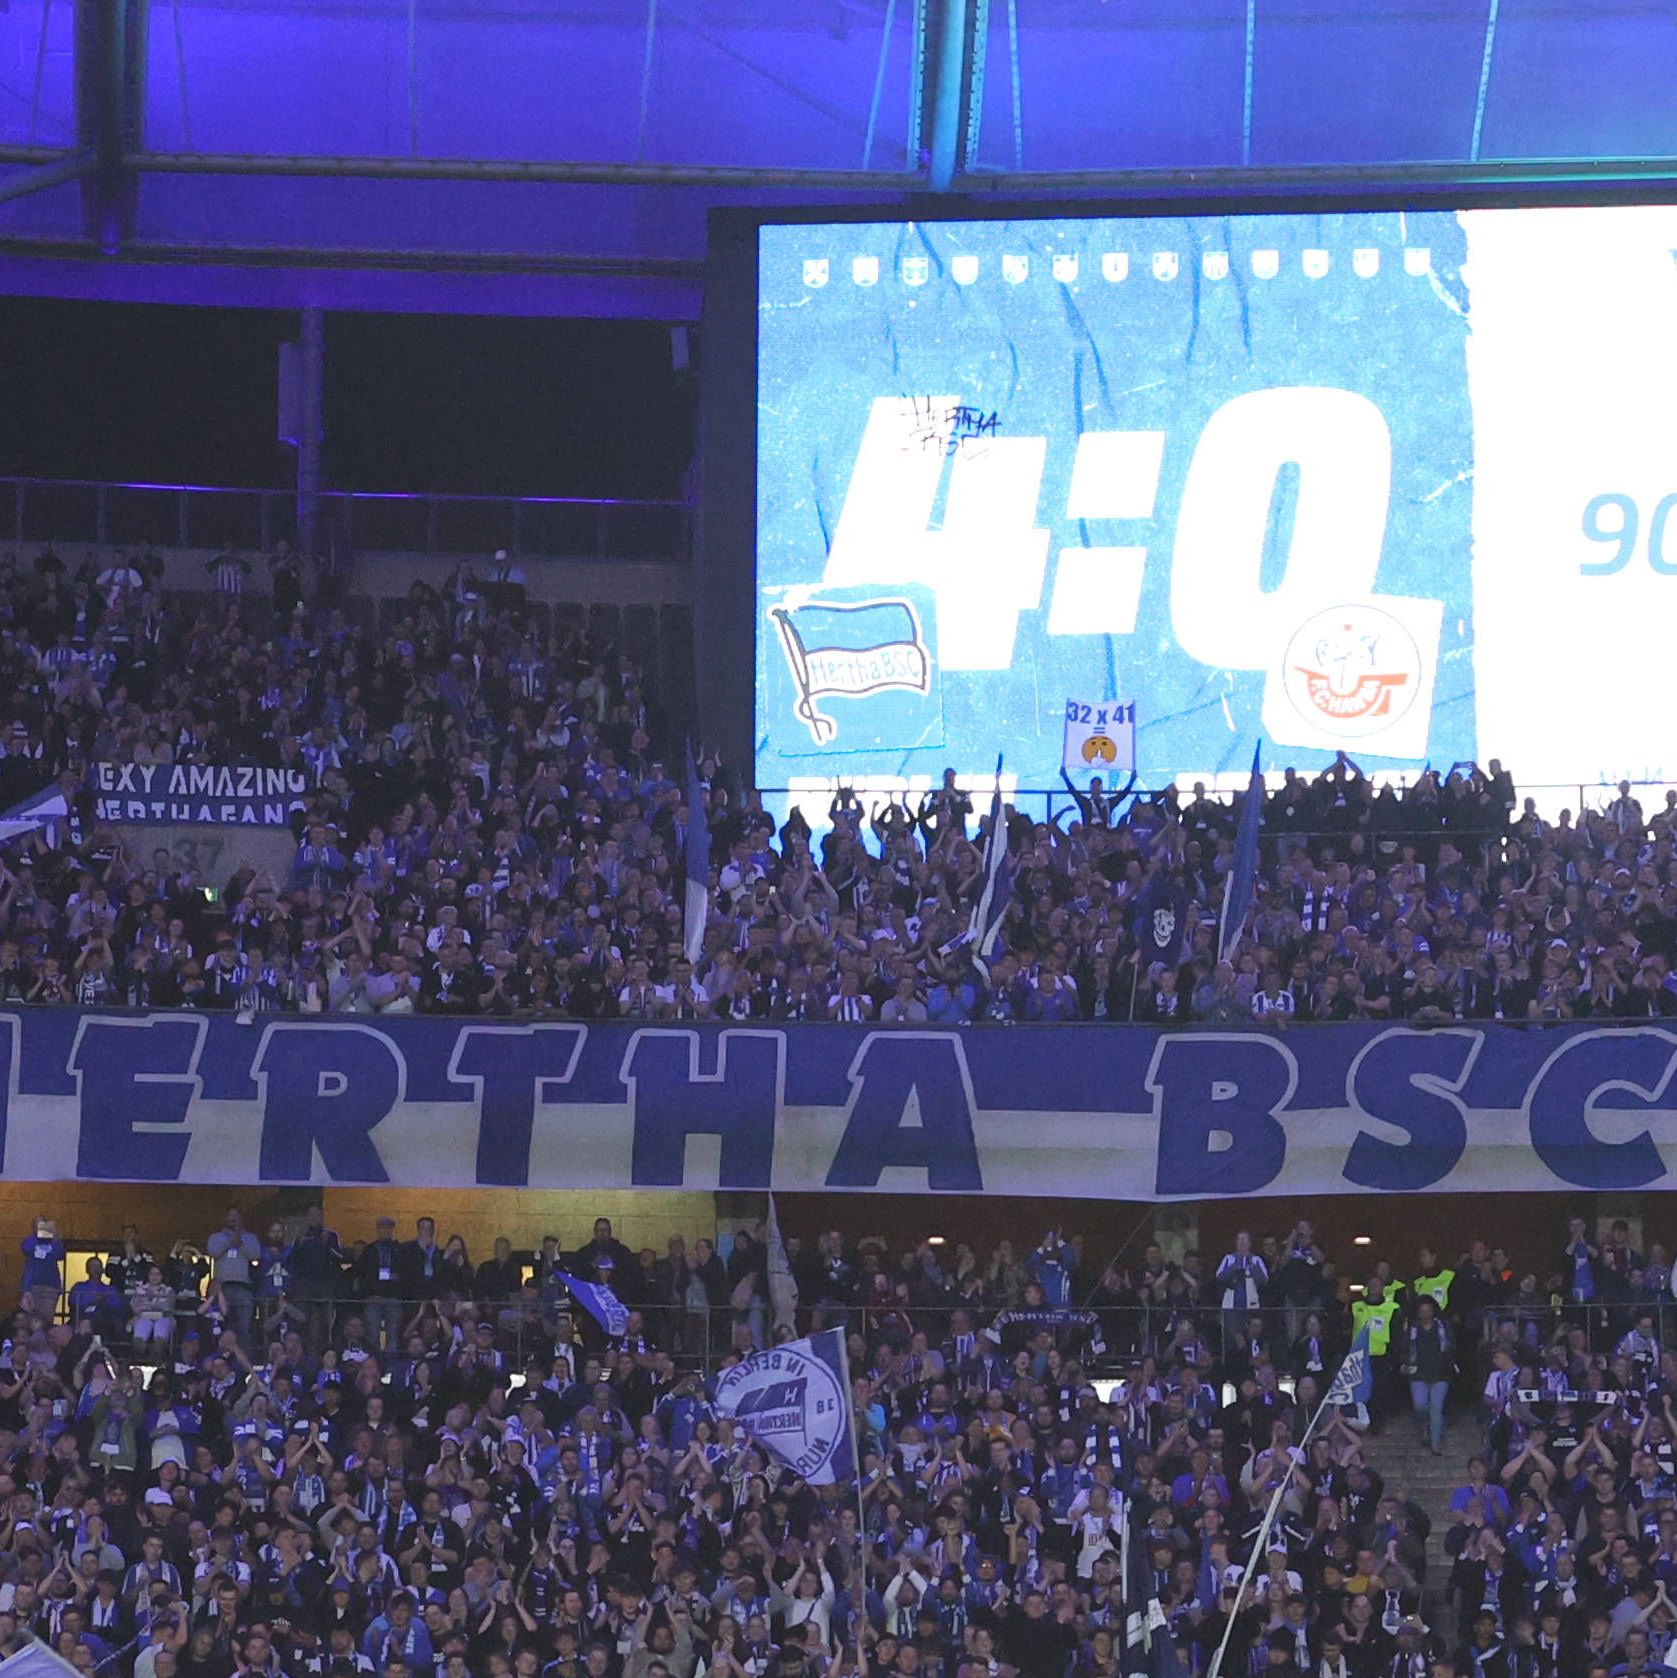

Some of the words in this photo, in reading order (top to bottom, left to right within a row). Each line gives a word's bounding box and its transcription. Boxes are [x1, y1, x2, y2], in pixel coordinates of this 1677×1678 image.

[820, 385, 1392, 672] 4:0
[1067, 702, 1092, 725] 32
[1112, 703, 1135, 726] 41
[93, 761, 157, 794] EXY
